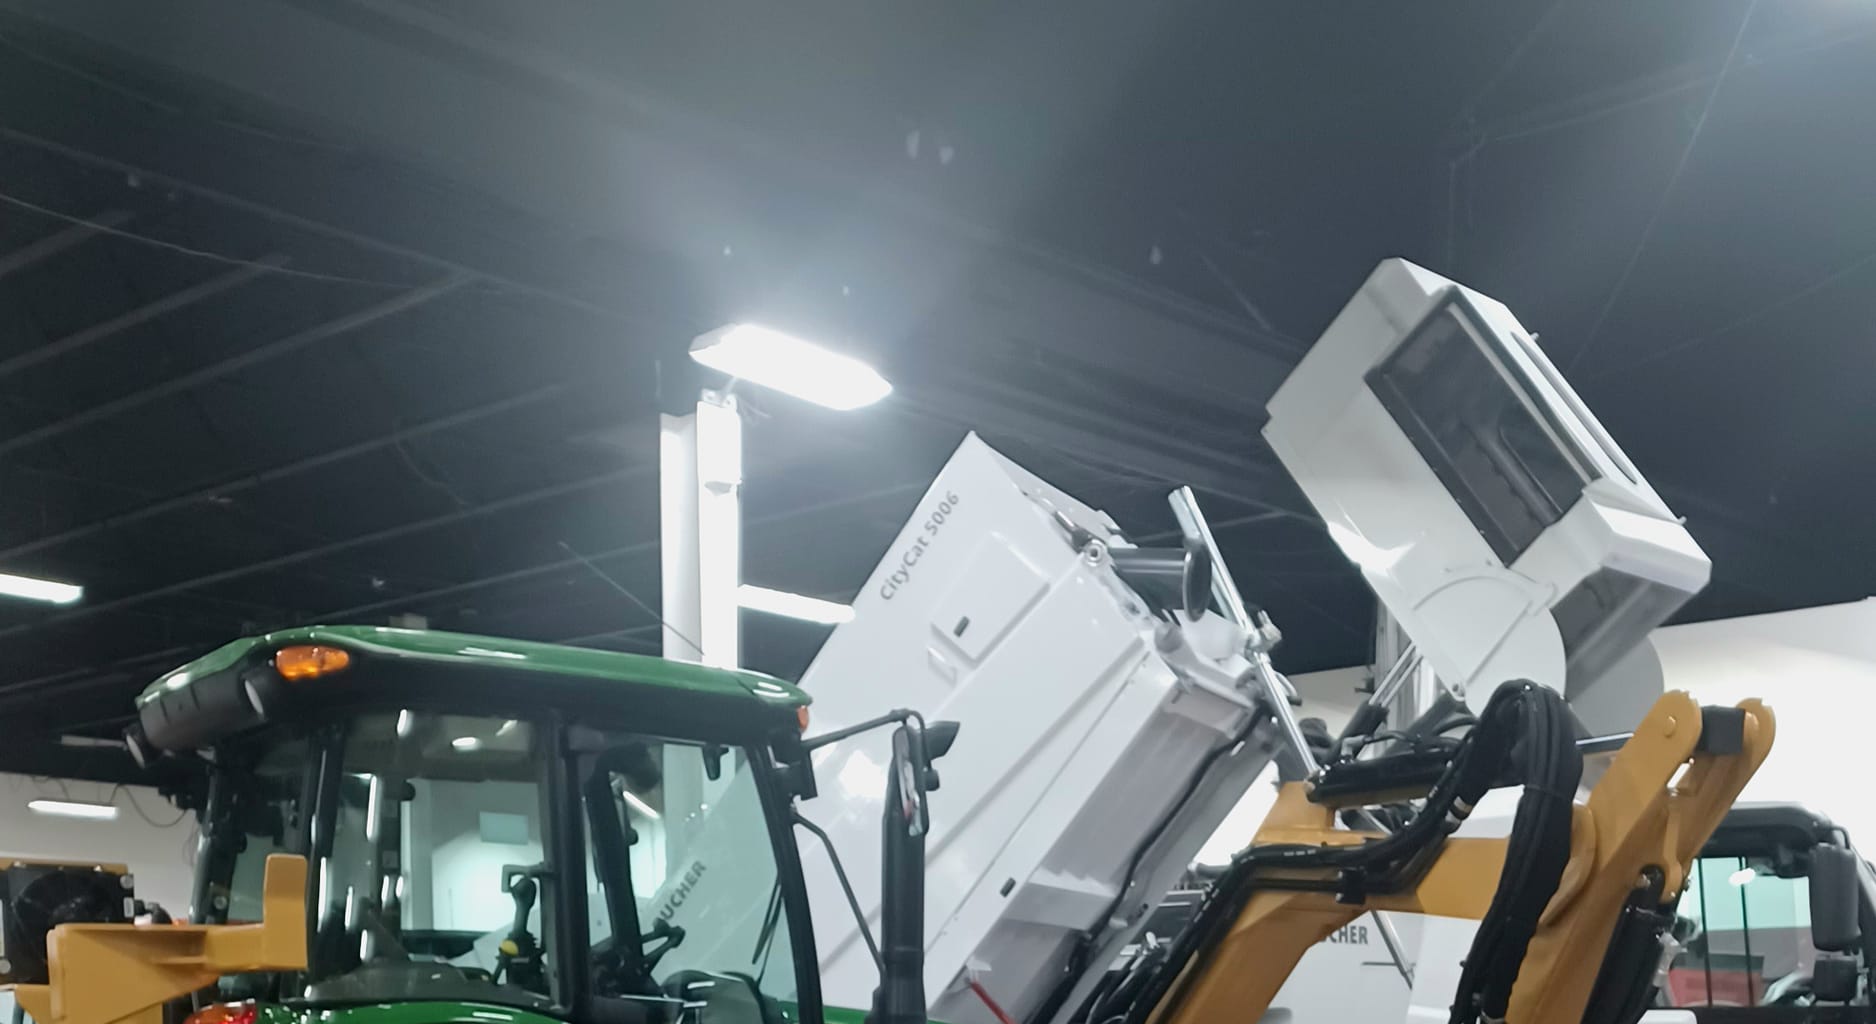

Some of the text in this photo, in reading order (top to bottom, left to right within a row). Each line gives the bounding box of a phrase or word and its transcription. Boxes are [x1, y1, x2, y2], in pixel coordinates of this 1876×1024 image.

[879, 490, 959, 600] CityCat 5006
[659, 860, 707, 920] UCHER
